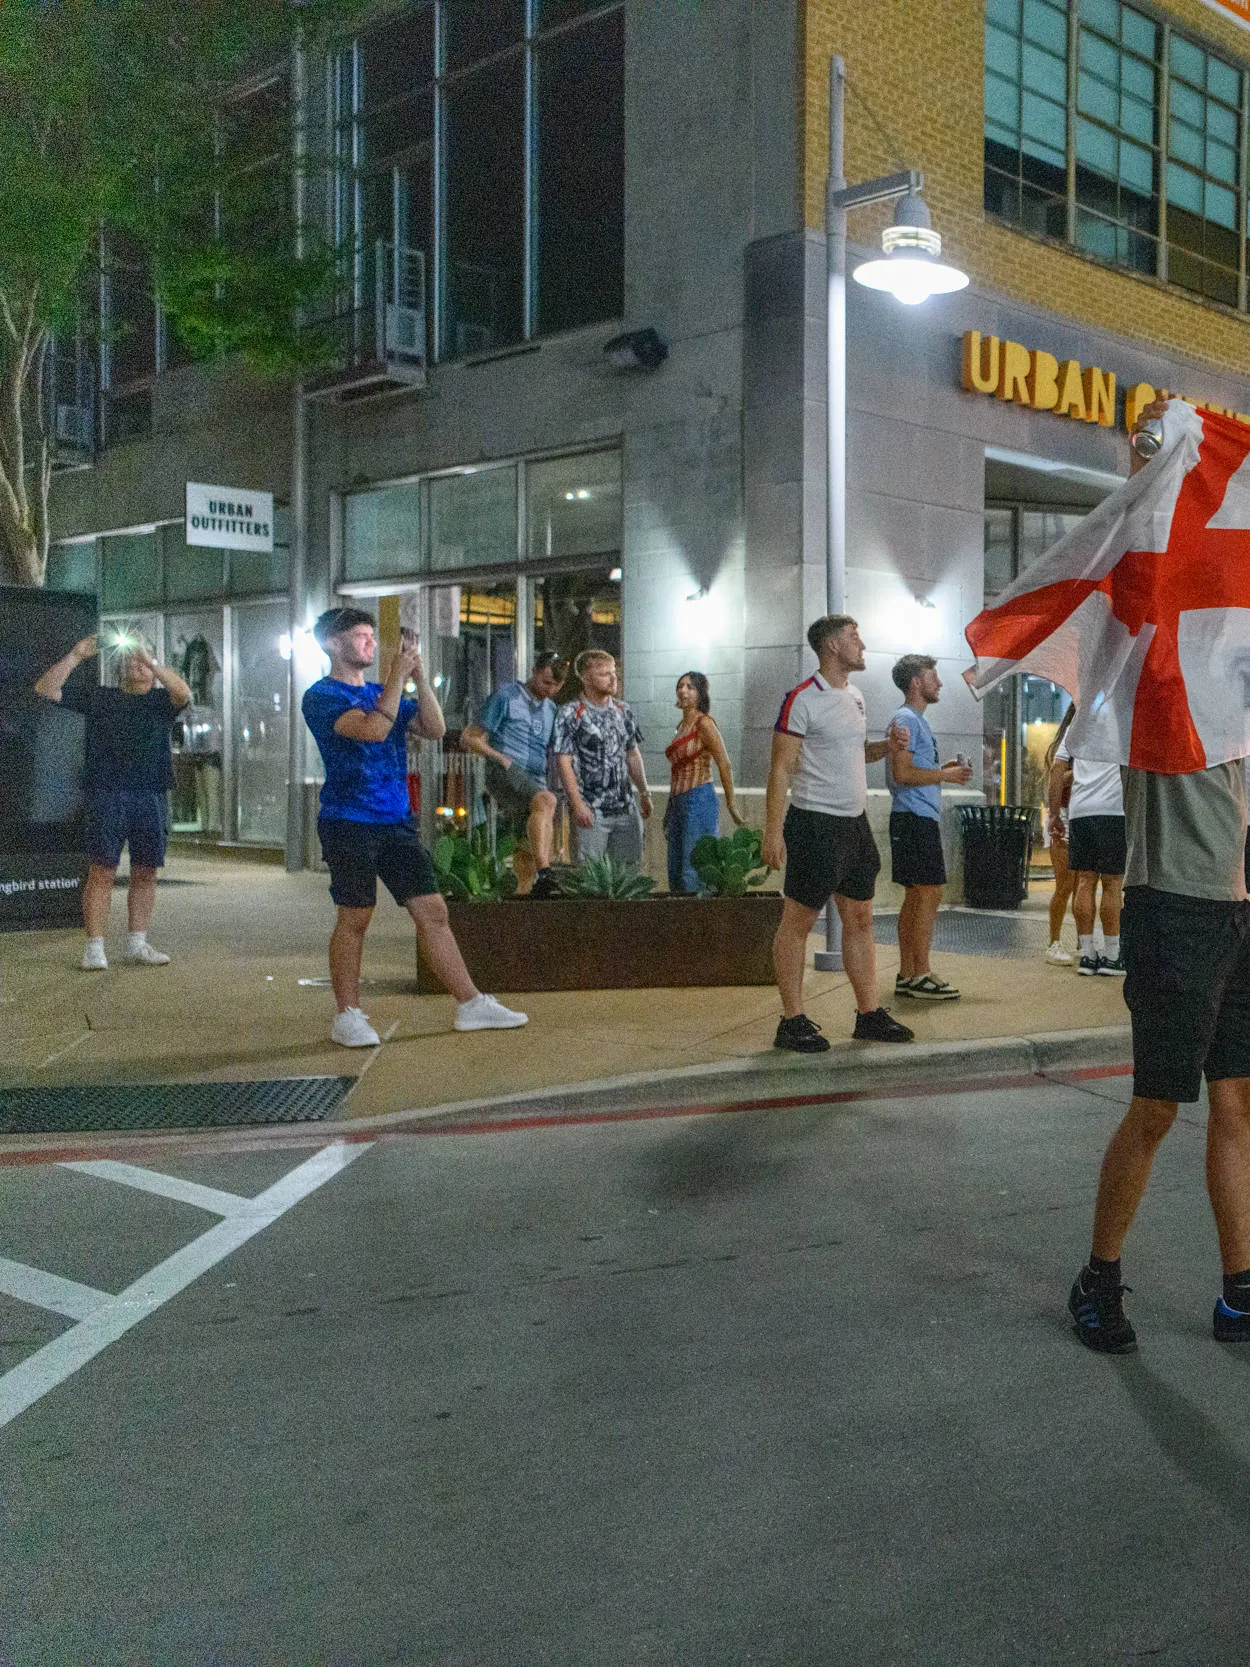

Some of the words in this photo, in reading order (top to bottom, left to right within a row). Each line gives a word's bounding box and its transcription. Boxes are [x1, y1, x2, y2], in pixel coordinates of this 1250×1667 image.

[962, 330, 1116, 427] URBAN
[208, 500, 253, 517] URBAN
[191, 514, 270, 537] OUTFITTERS
[38, 877, 79, 890] station
